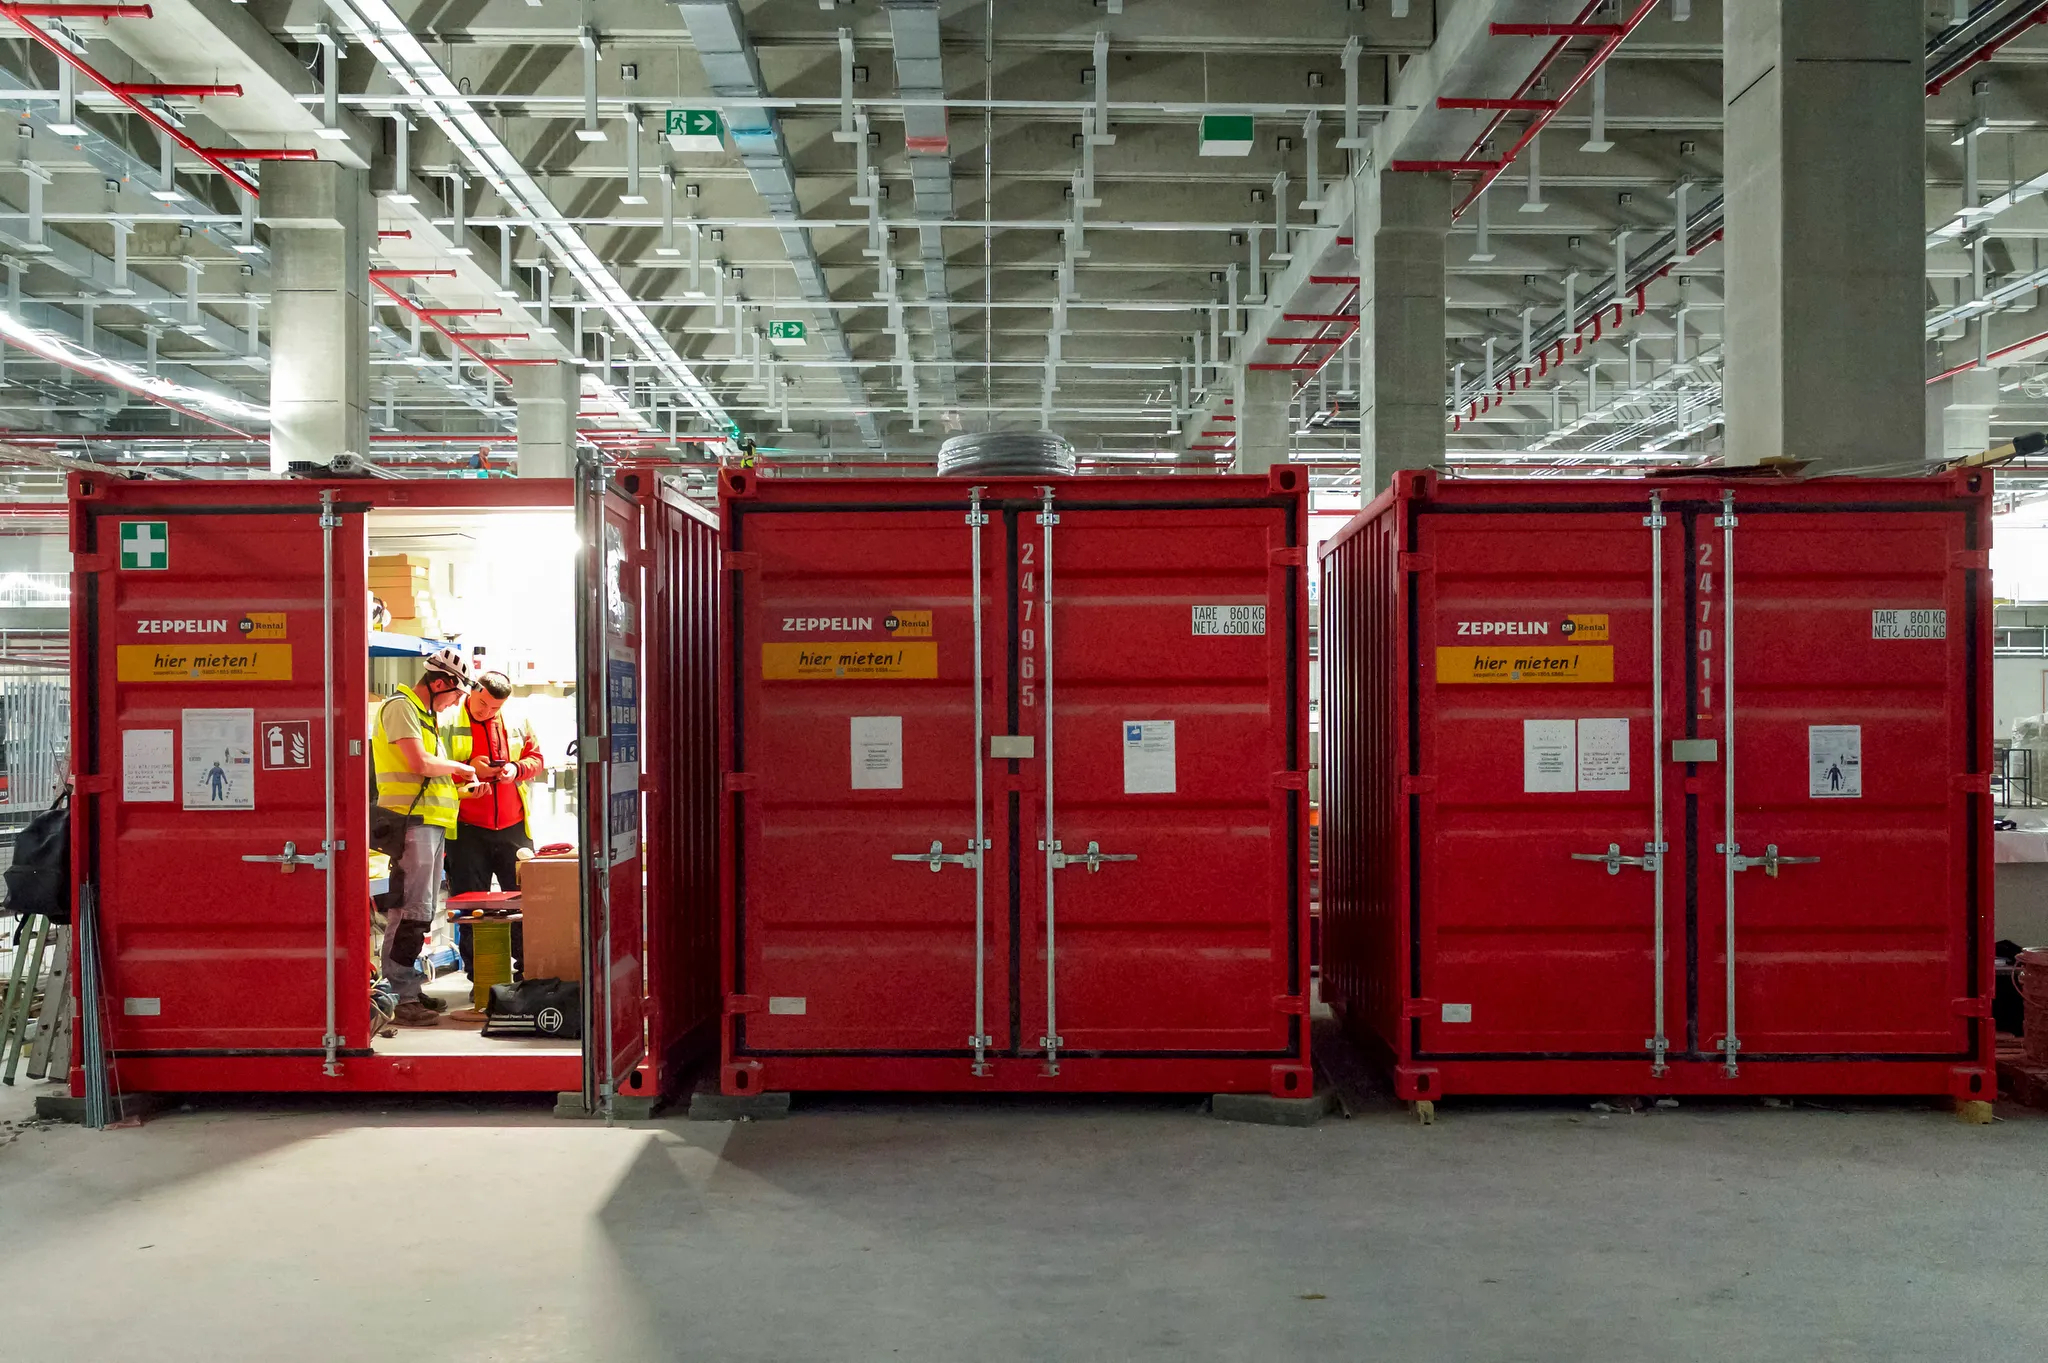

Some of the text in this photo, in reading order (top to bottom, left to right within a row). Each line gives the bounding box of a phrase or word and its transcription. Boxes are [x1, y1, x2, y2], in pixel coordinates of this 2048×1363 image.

[1194, 606, 1265, 620] TARE 860 KG
[1874, 611, 1945, 624] TARE 860 KG
[137, 620, 228, 633] ZEPPELIN
[782, 617, 872, 631] ZEPPELIN
[1021, 543, 1034, 706] 247965
[1223, 621, 1250, 634] 6500
[1252, 621, 1265, 634] KG
[1457, 622, 1548, 635] ZEPPELIN
[1699, 544, 1712, 708] 247011
[1904, 625, 1930, 638] 6500
[1932, 625, 1945, 638] KG
[154, 654, 186, 668] hier
[799, 651, 832, 666] hier
[1474, 655, 1507, 670] hier
